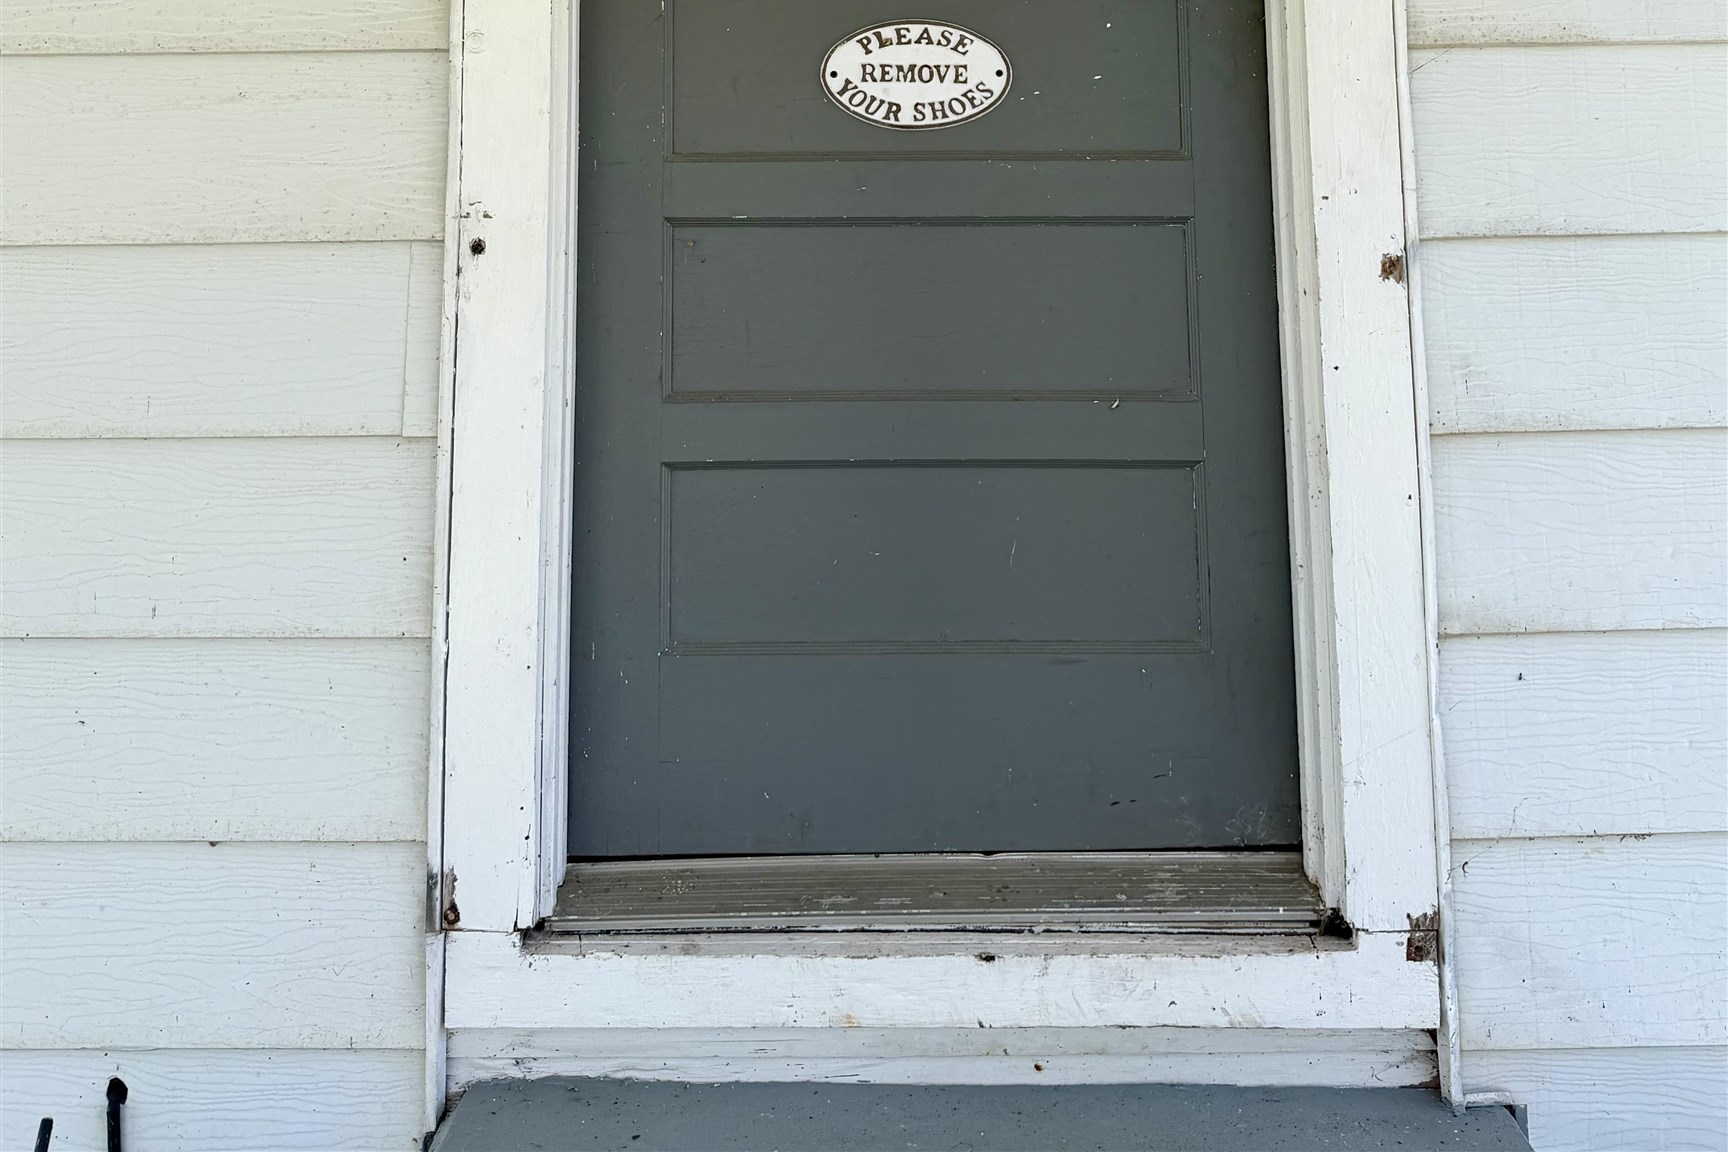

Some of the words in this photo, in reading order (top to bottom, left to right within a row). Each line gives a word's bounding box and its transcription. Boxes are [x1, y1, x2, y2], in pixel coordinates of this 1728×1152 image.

[856, 27, 974, 56] PLEASE
[861, 63, 968, 84] REMOVE
[836, 78, 901, 122] YOUR
[913, 81, 994, 122] SHOES
